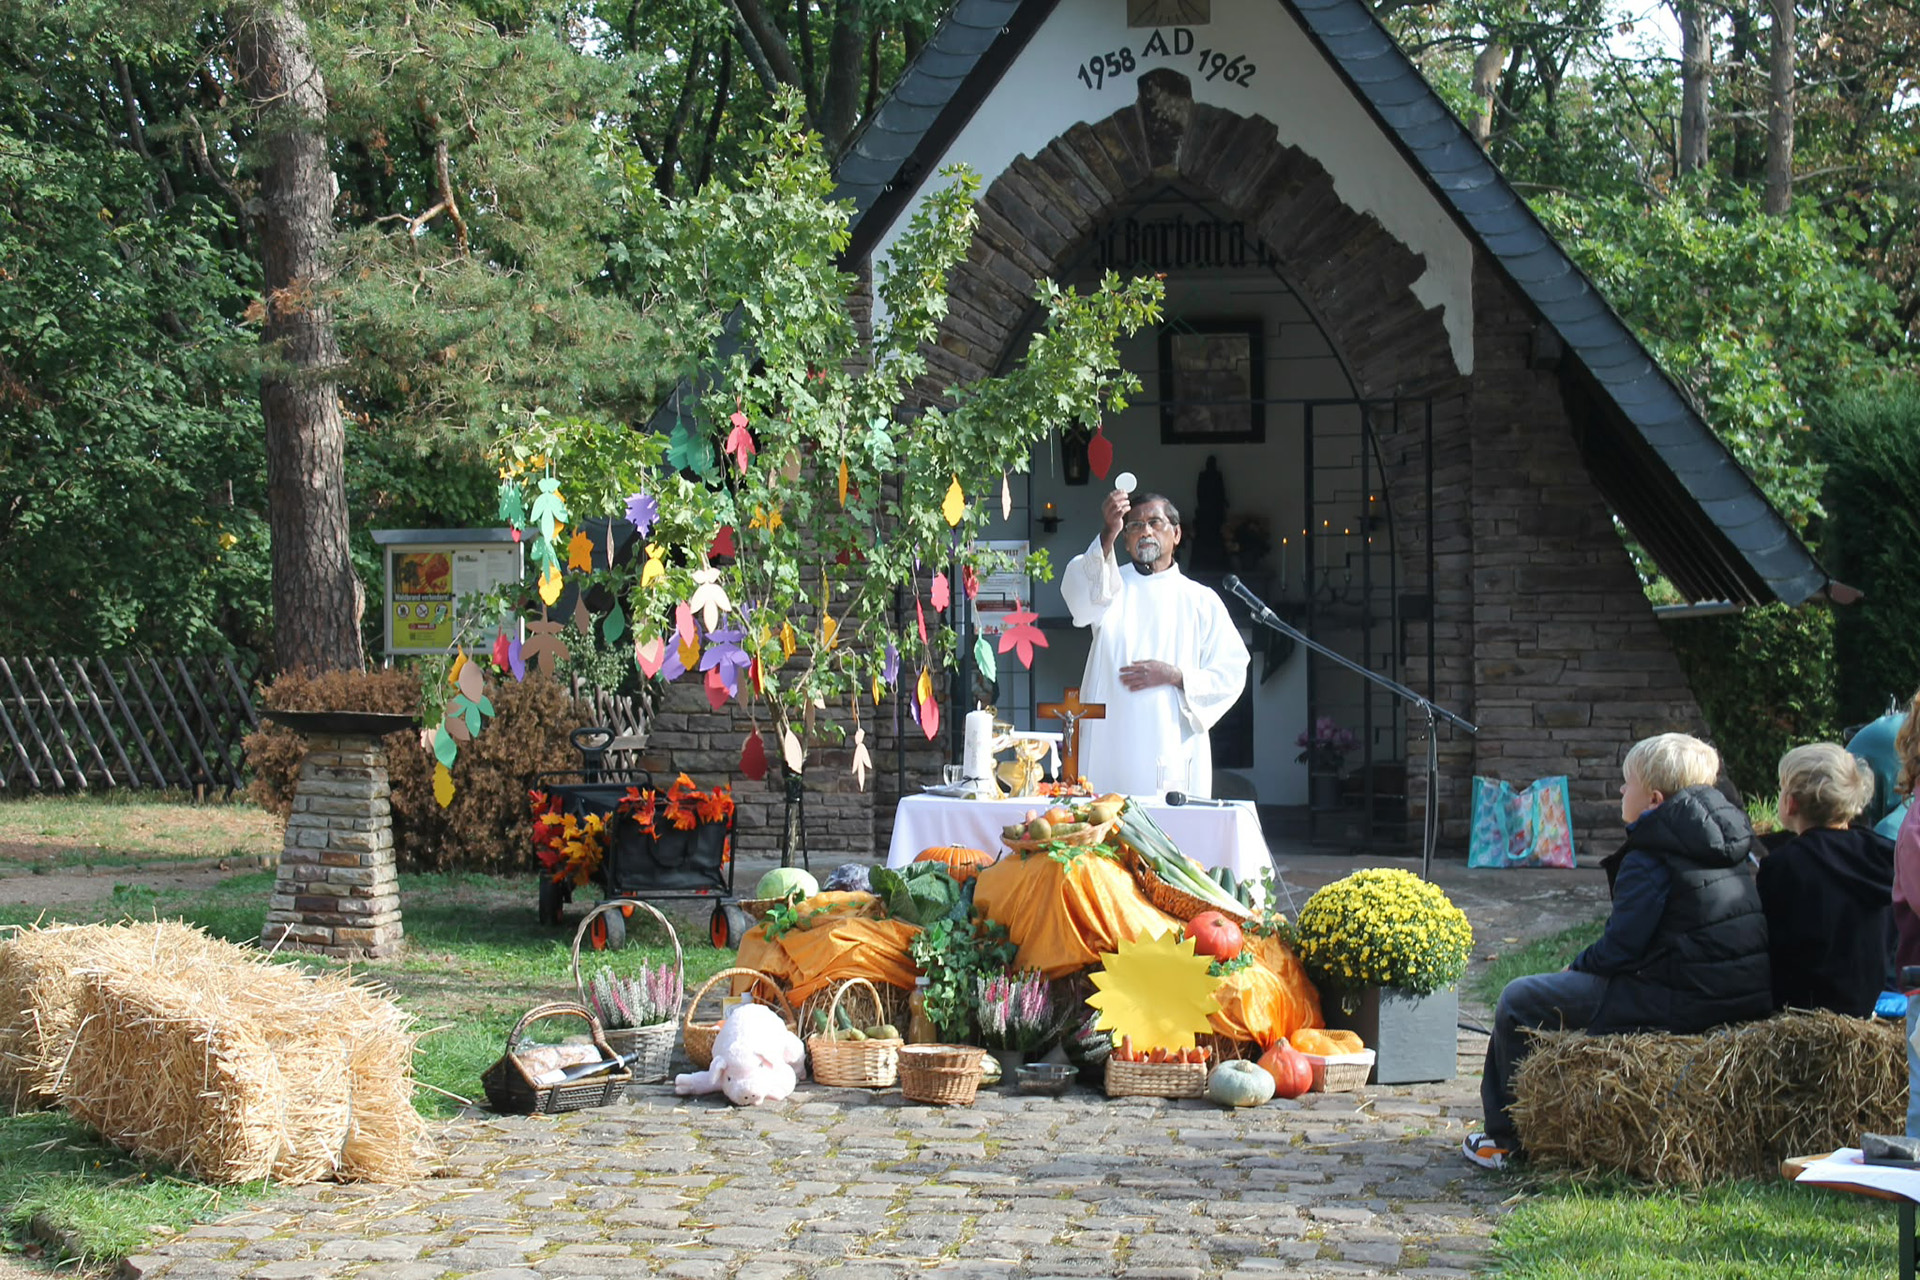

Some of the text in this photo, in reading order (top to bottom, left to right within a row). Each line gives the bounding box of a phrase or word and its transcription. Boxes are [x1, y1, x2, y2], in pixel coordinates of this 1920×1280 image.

[1077, 28, 1257, 90] 1958 AD 1962
